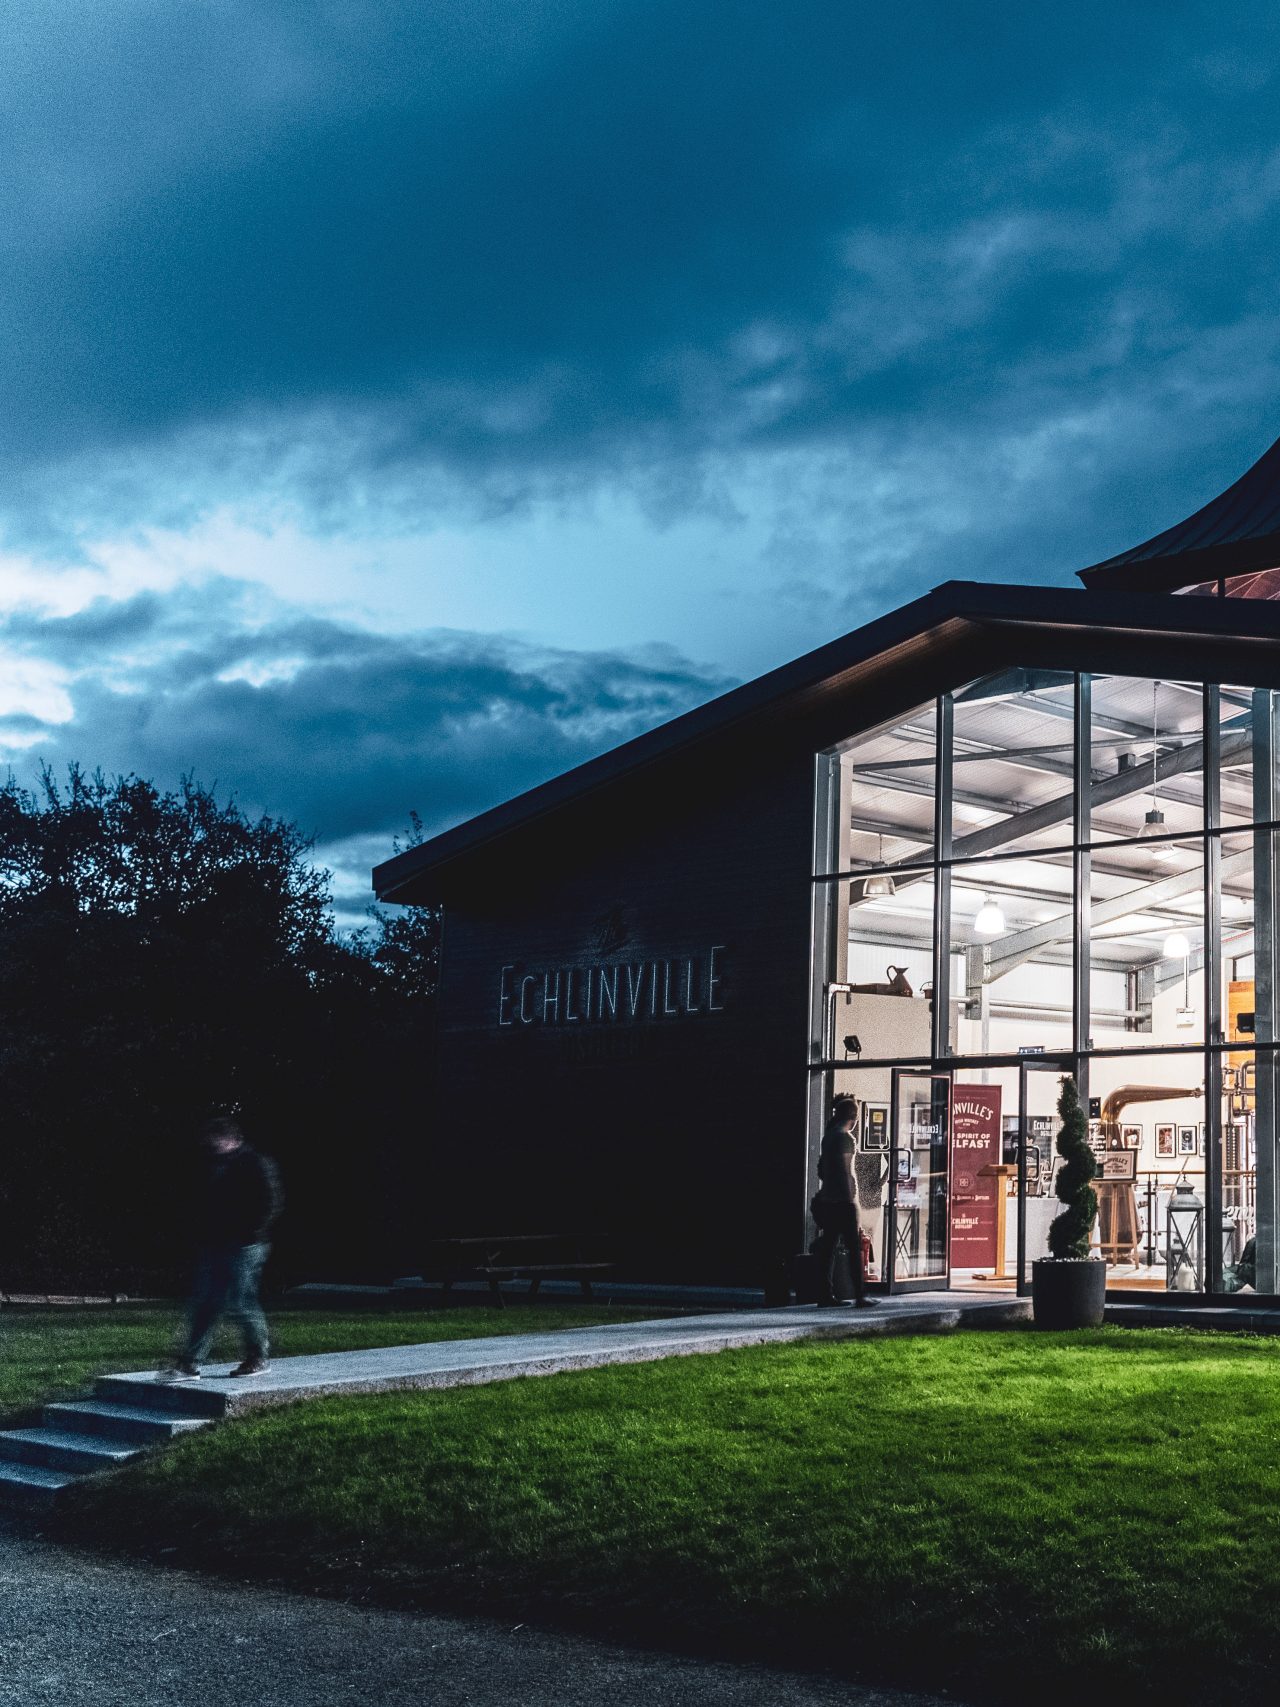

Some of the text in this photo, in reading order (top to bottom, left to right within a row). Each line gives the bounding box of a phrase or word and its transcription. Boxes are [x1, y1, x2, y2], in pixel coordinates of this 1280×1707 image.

[499, 946, 727, 1025] ECHLINVILLE
[952, 1102, 994, 1121] NVILLE'S
[952, 1139, 991, 1149] ELFAST
